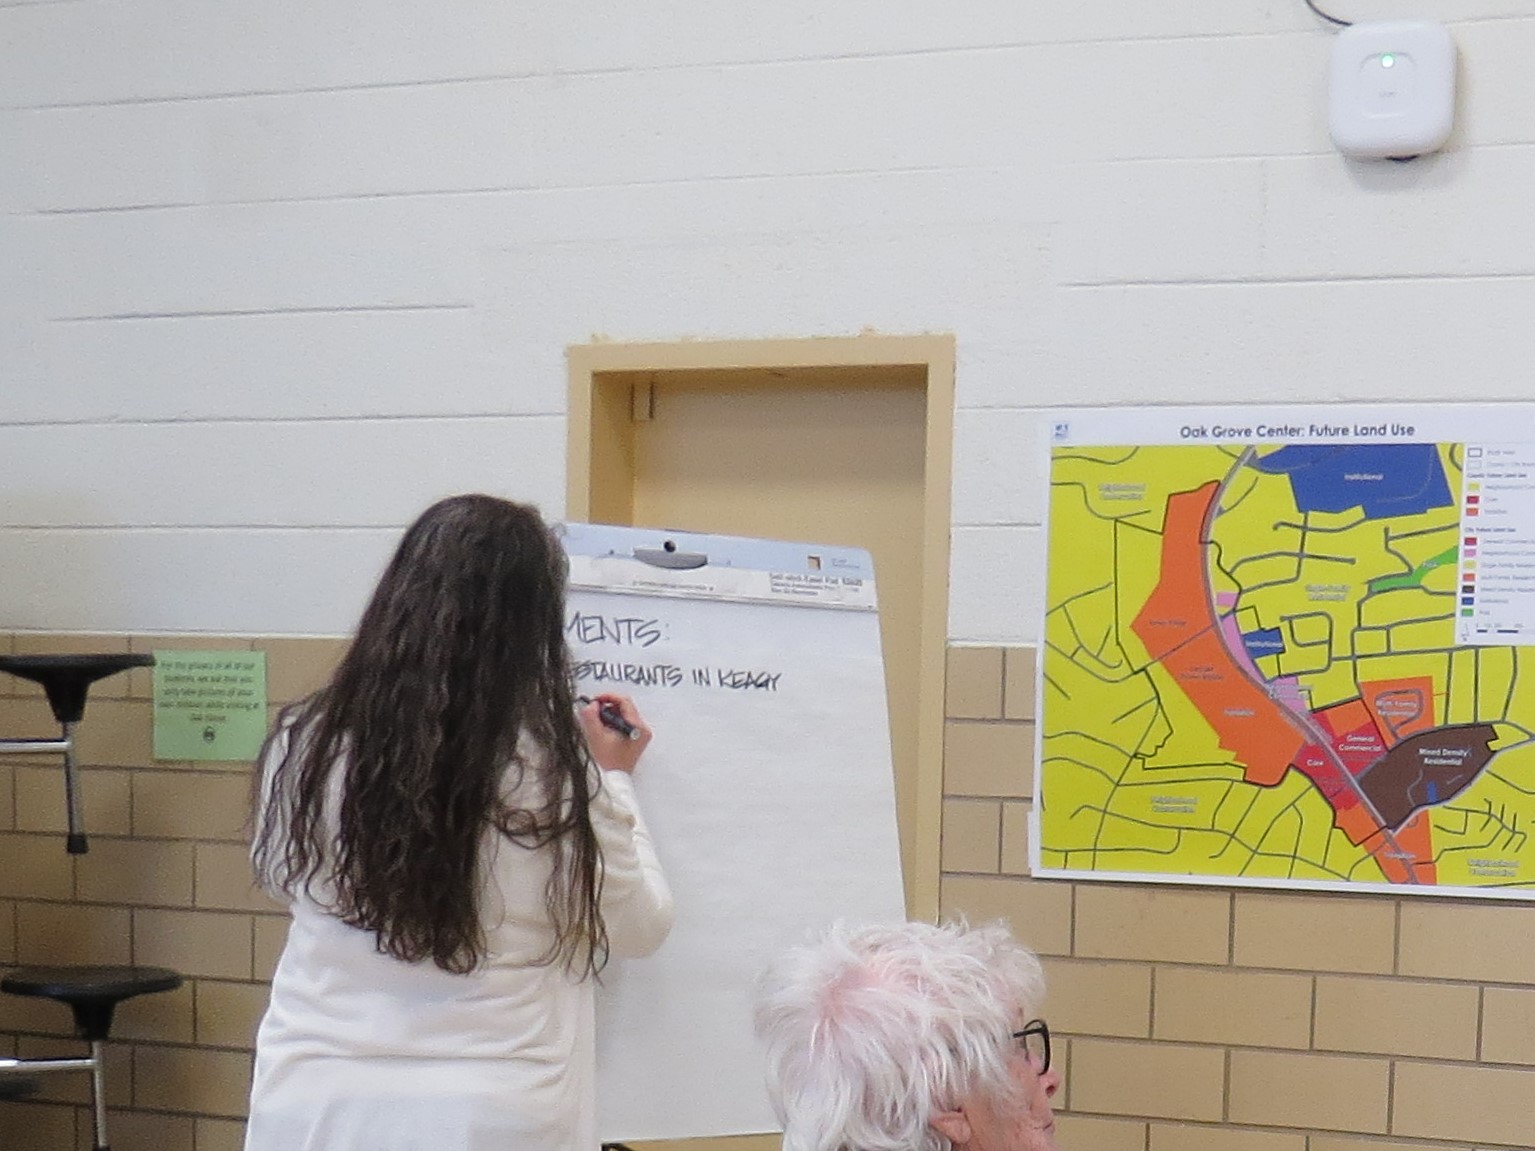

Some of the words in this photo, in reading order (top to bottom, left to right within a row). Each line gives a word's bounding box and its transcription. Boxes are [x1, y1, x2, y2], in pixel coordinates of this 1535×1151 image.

[1180, 425, 1207, 438] Oak
[1211, 425, 1252, 438] Grove
[1256, 424, 1304, 438] Center:
[1309, 424, 1349, 437] Future
[1354, 424, 1387, 437] Land
[1391, 424, 1415, 437] Use
[692, 667, 711, 687] IN
